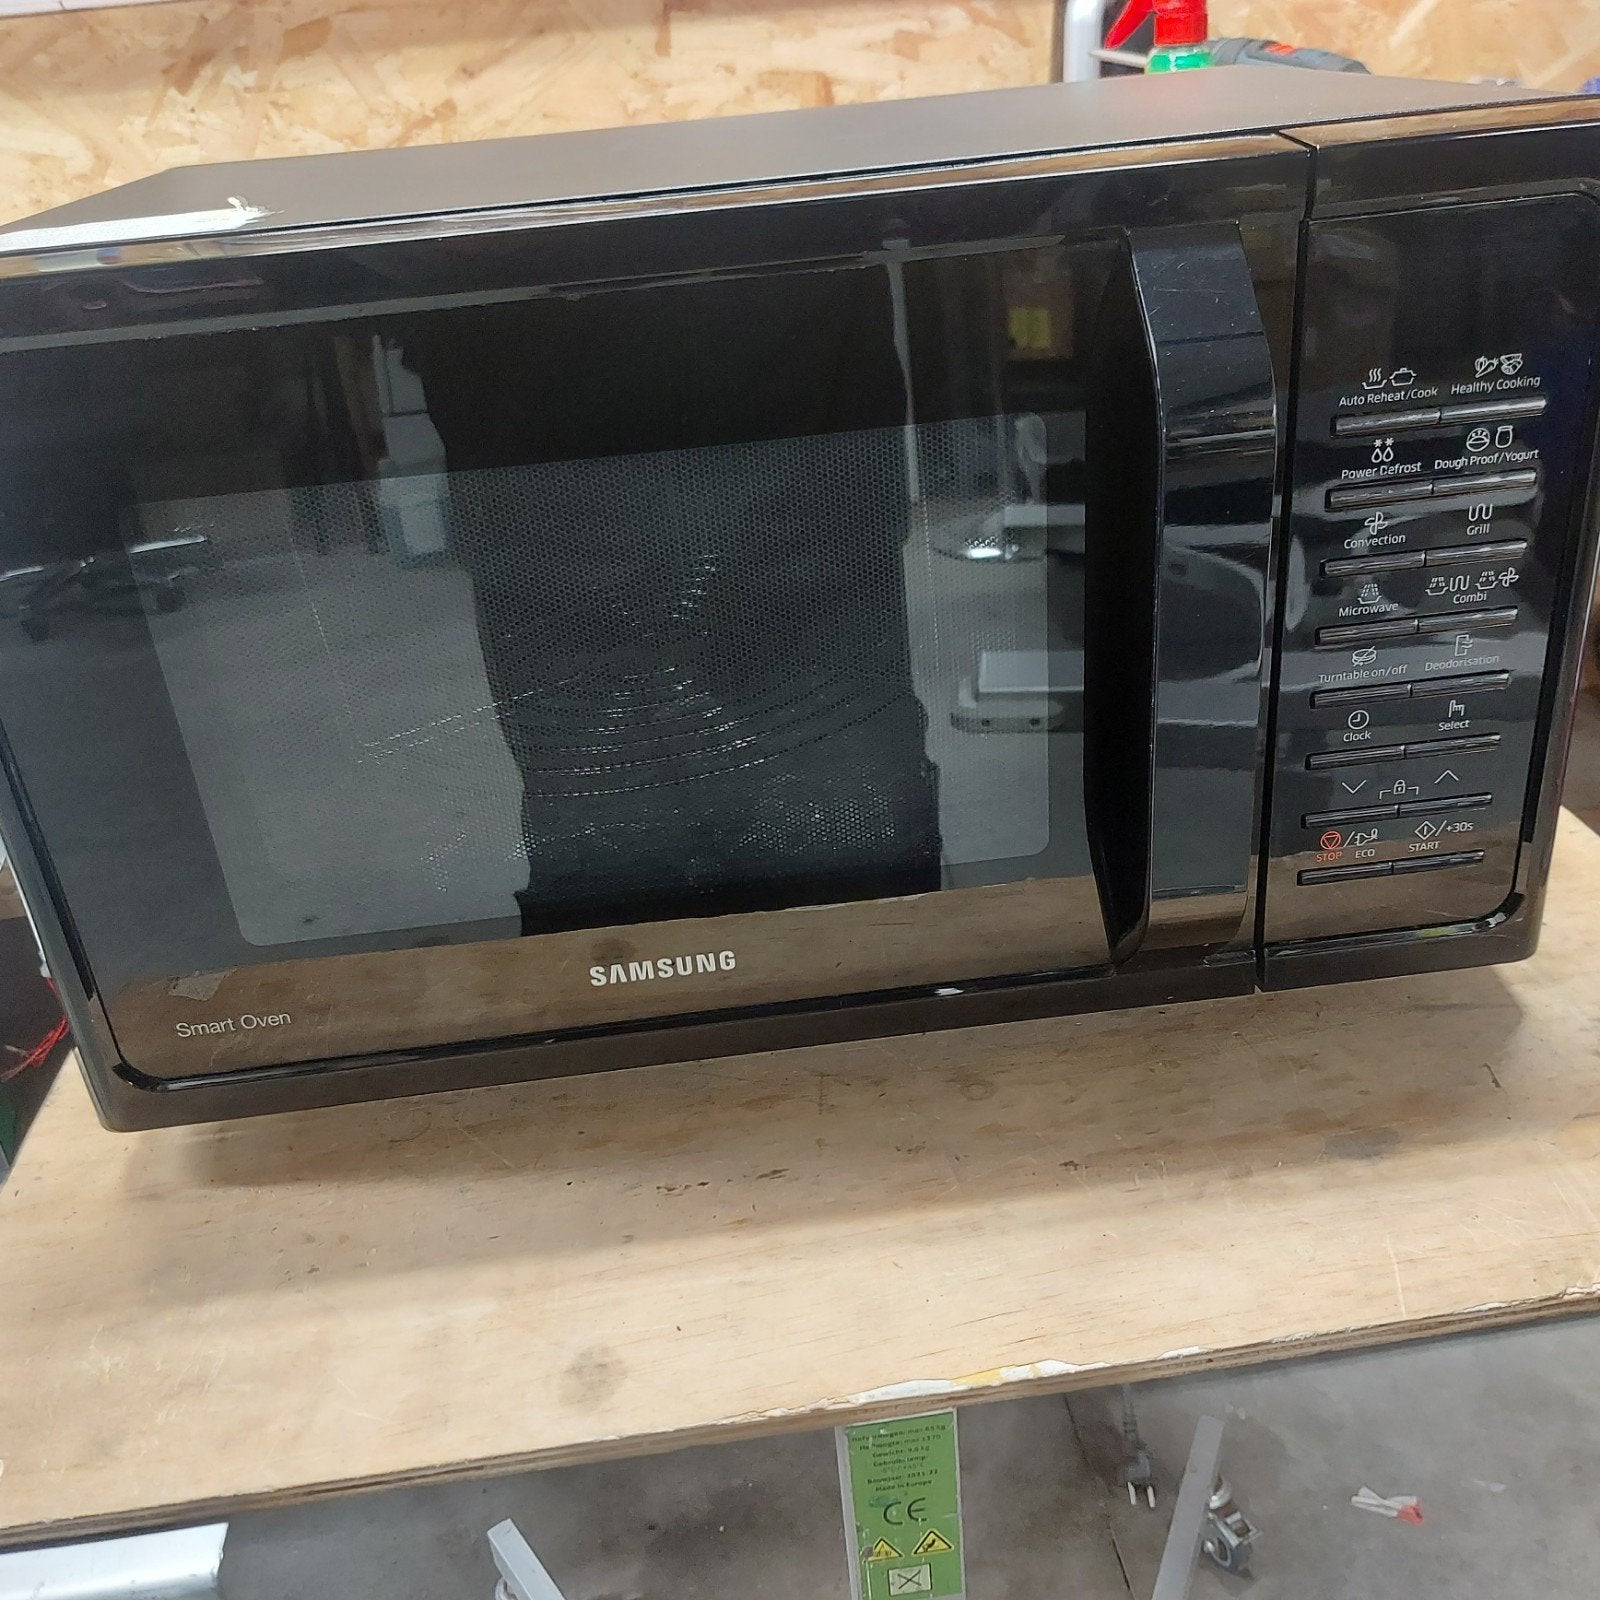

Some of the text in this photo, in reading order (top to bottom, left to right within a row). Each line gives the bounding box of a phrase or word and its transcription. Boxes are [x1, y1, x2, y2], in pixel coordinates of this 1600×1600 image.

[1450, 376, 1541, 395] Healthy Cooking
[1338, 395, 1365, 407] Auto
[1434, 449, 1539, 470] Dough Proof/Yogurt
[1341, 461, 1422, 480] Power Defrost
[1466, 523, 1490, 536] Grill
[1343, 534, 1406, 550] Convection
[1453, 592, 1488, 605] Combi
[1338, 602, 1399, 618] Microwave
[1424, 655, 1499, 672] Deodorisation
[1318, 664, 1409, 684] Turntable on/off
[1438, 719, 1471, 732] Select
[1343, 730, 1372, 743] Clock
[1355, 849, 1376, 860] ECO
[1408, 841, 1441, 853] START
[1316, 852, 1343, 863] STOP
[589, 949, 738, 987] SAMSUNG
[175, 1010, 292, 1039] Smart Oven
[883, 1497, 927, 1525] CE
